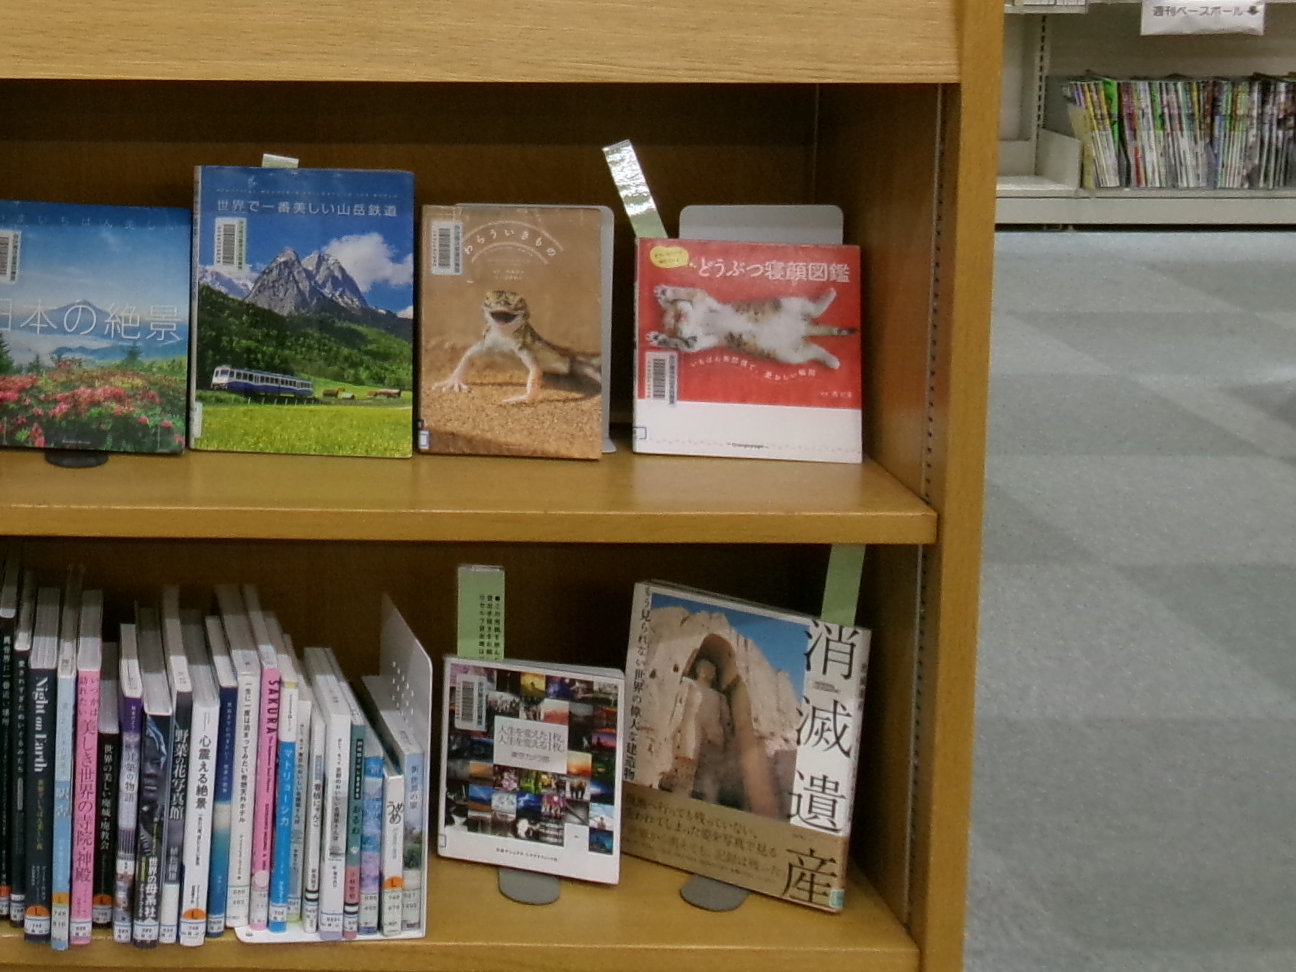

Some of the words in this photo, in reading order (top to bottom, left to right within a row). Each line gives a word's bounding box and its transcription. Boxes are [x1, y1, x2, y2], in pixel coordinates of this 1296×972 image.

[1152, 4, 1245, 19] 週刊ベースボール
[216, 199, 399, 218] 世界で一番美しい山岳鉄道
[464, 228, 558, 257] わらういきもの
[697, 256, 852, 284] どうぶつ寝顔図鑑
[34, 676, 51, 716] Night
[78, 676, 90, 716] 訪れたい
[89, 676, 100, 716] いつかは
[623, 586, 654, 783] もう見られない世界の偉大な建造物
[35, 717, 49, 732] on
[265, 678, 282, 735] SAKURA
[34, 732, 50, 774] Earth
[194, 733, 213, 812] 心震える絶景
[782, 619, 861, 910] 消滅遺産
[168, 728, 190, 822] 野菜の花写真館
[278, 747, 295, 828] マトリョーシカ
[74, 719, 98, 885] 美しき世界の寺院・神殿
